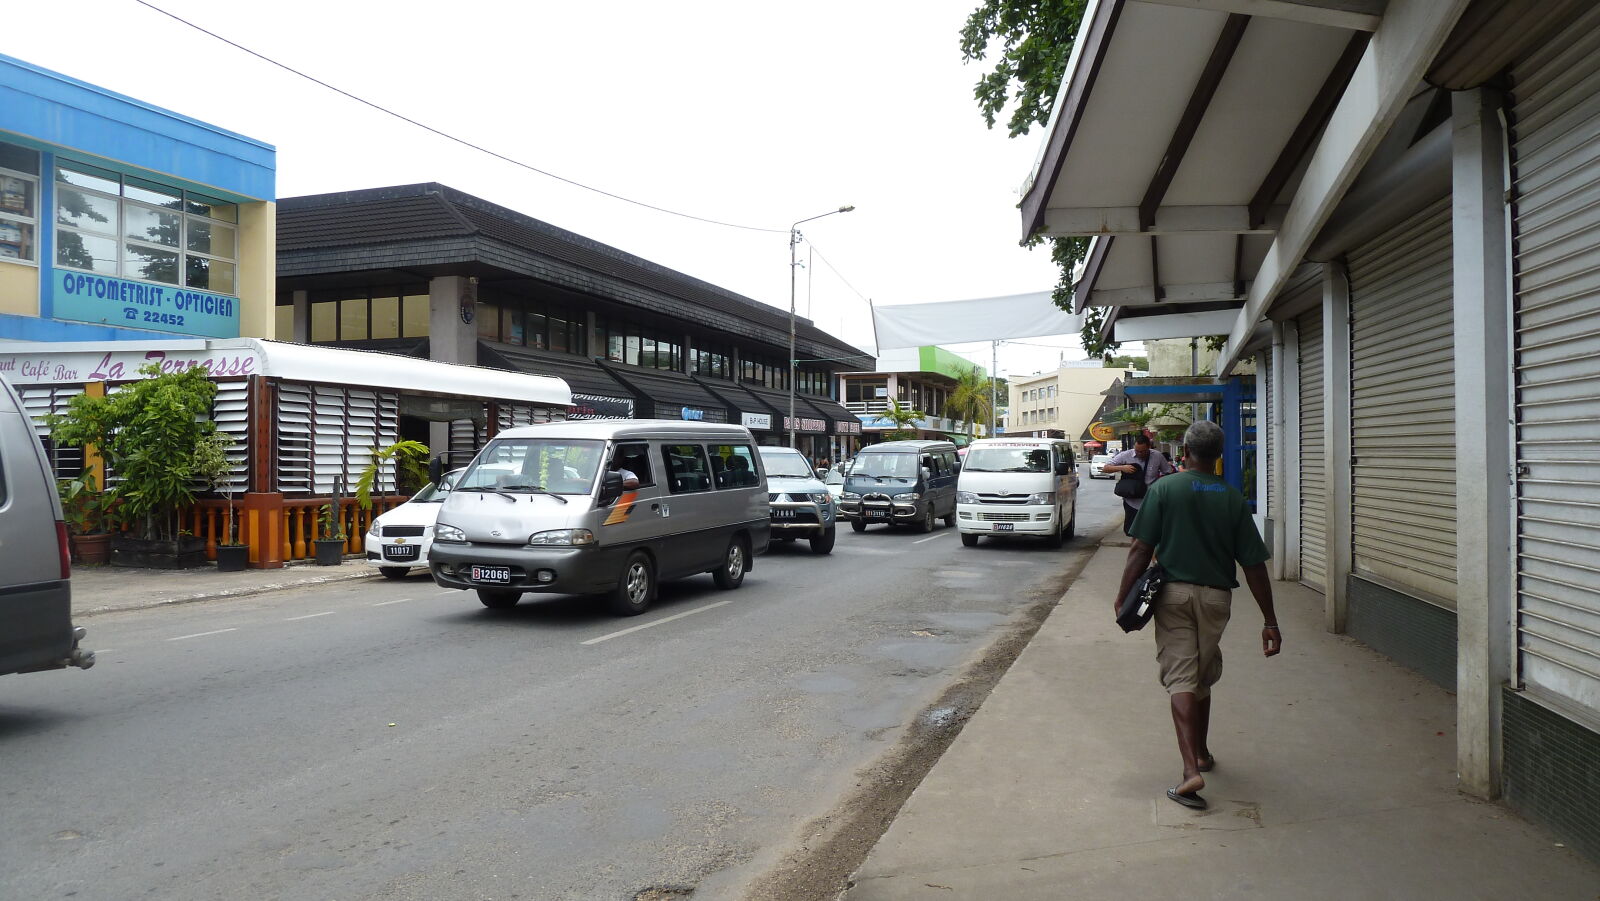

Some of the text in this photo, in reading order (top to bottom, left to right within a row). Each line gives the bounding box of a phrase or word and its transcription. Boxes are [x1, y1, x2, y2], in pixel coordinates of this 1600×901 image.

[63, 273, 163, 306] OPTOMETRIST
[174, 291, 232, 317] OPTICIEN
[143, 310, 185, 327] 22452
[21, 360, 49, 381] Café
[53, 364, 79, 381] Bar
[88, 351, 126, 380] La
[390, 546, 410, 555] 11017
